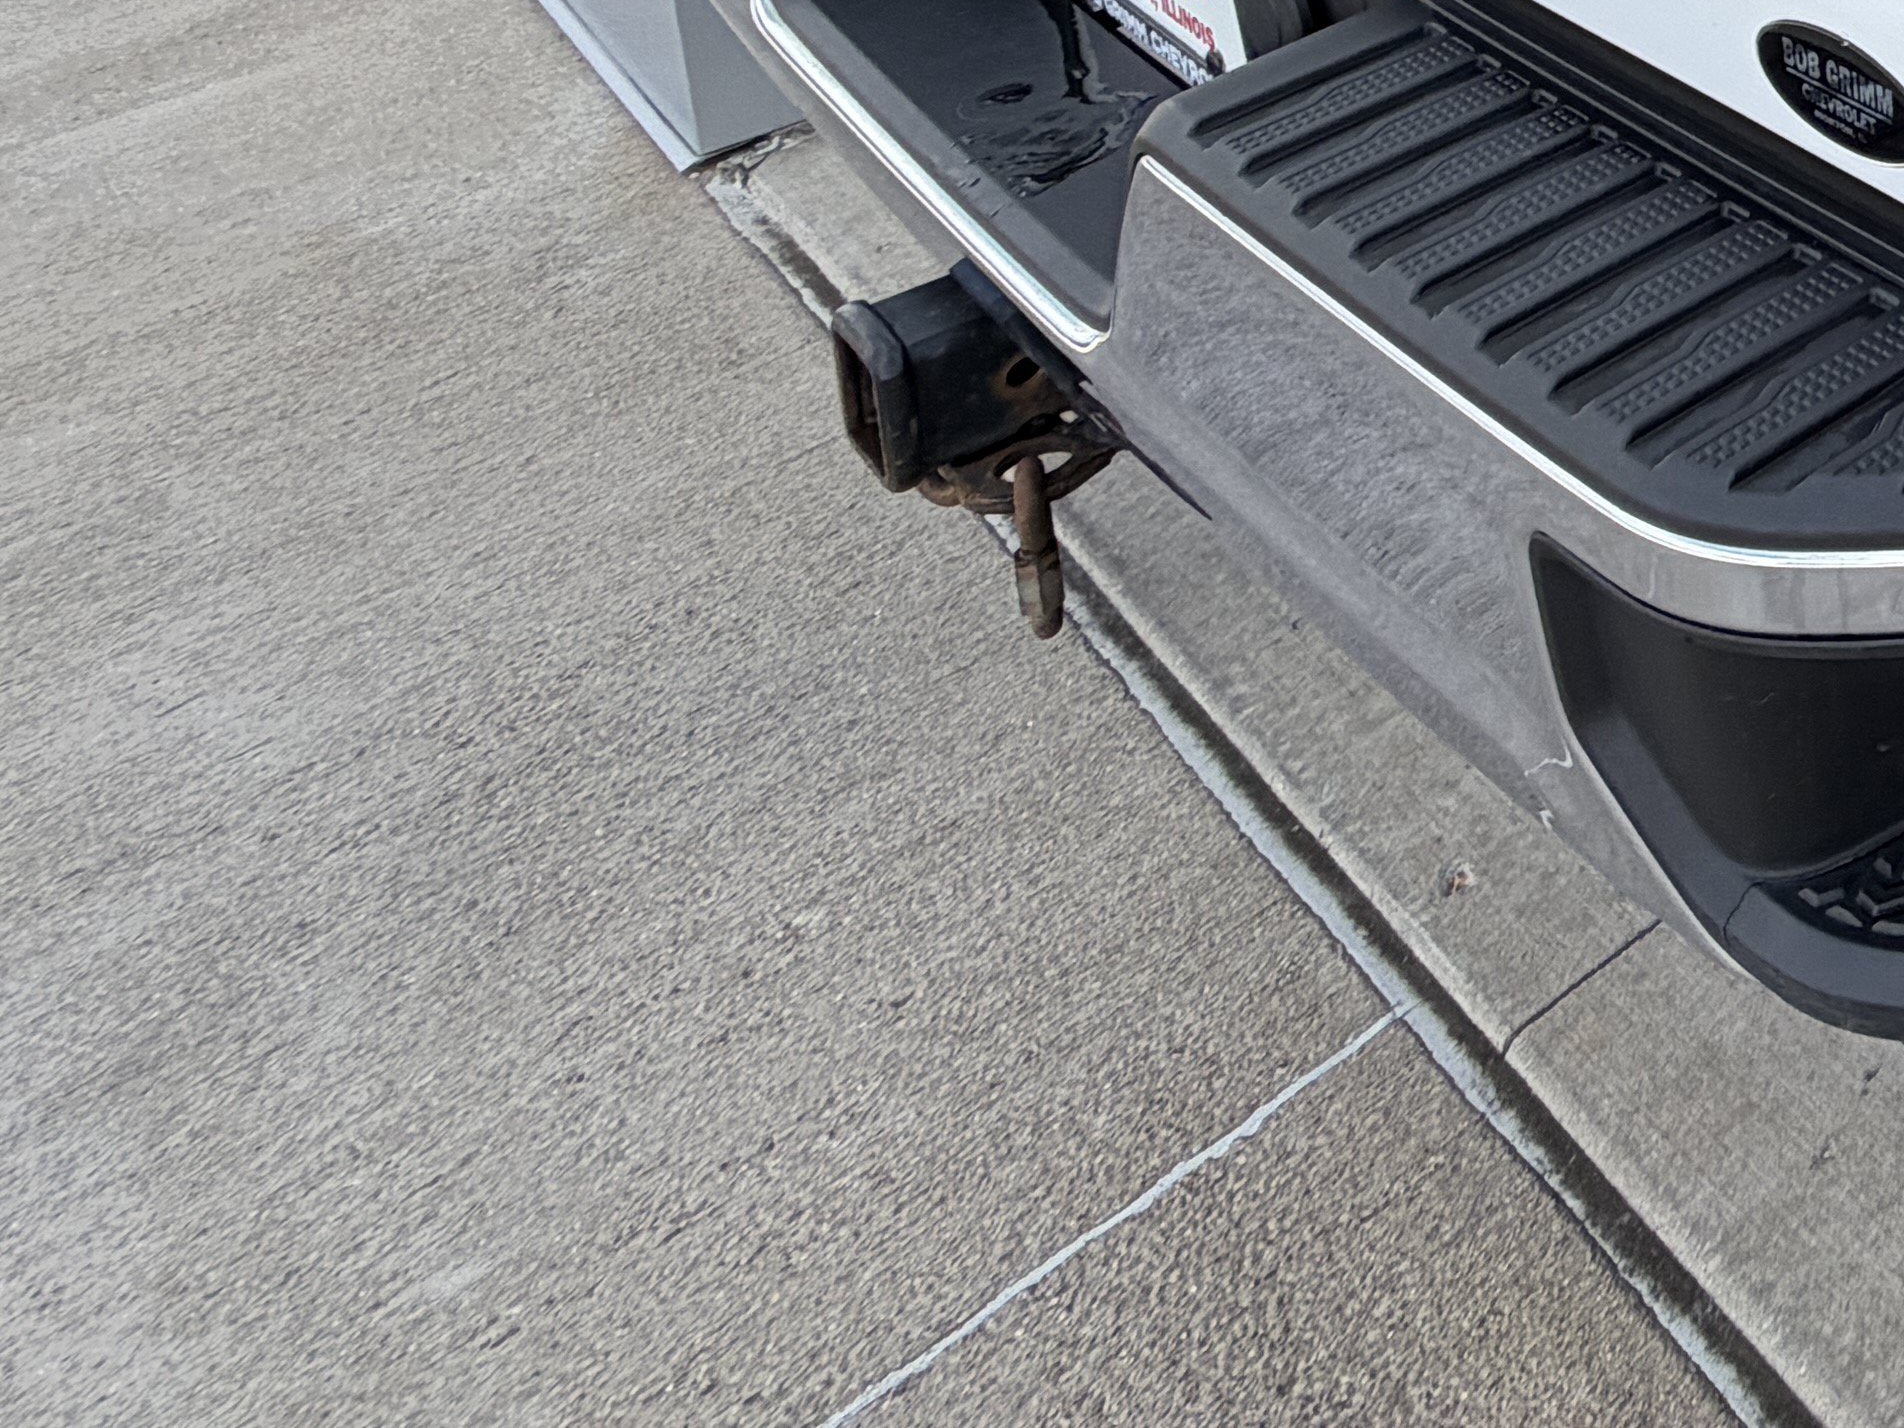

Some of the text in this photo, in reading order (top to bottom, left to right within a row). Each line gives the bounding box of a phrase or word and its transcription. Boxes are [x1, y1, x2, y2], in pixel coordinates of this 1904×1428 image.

[1781, 36, 1894, 118] BOB GRIMM
[1802, 83, 1877, 136] CHEVROLET
